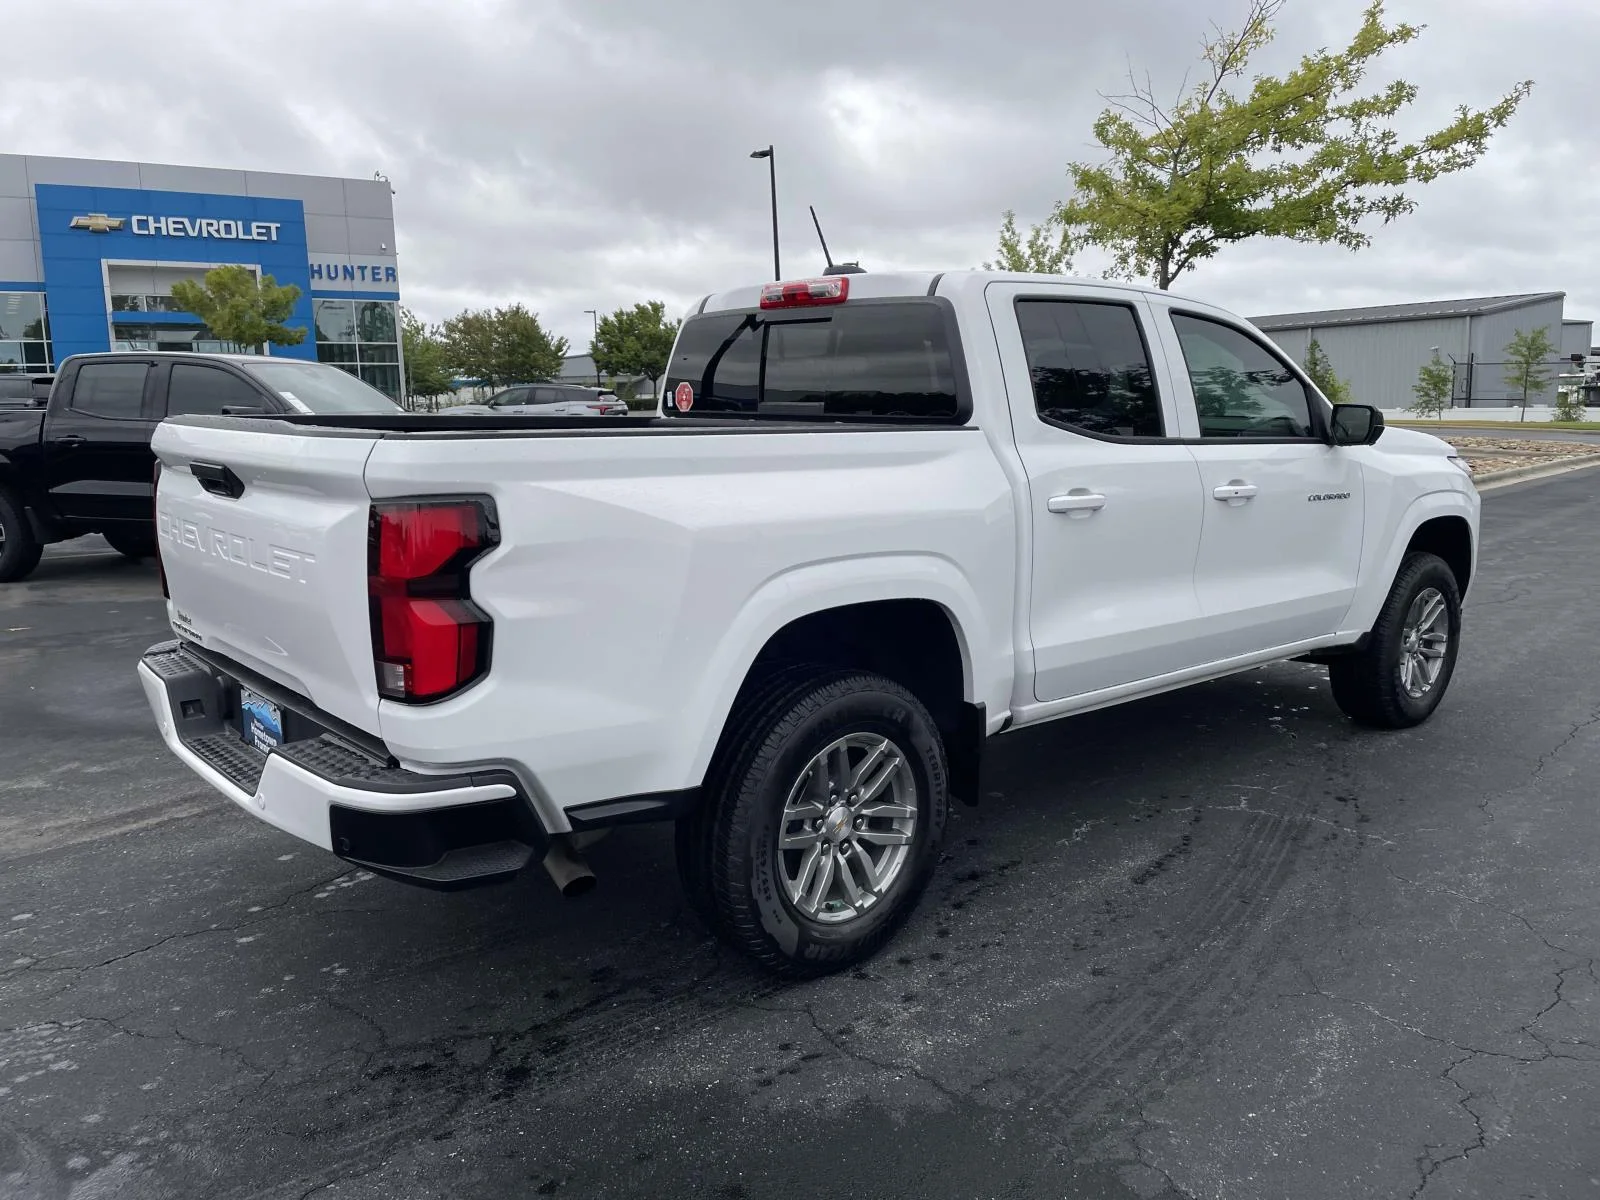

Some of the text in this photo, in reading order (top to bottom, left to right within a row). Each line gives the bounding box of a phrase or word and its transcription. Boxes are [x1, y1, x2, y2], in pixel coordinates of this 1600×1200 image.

[131, 215, 281, 242] CHEVROLET
[310, 263, 397, 283] HUNTER
[1307, 492, 1351, 502] COLORADO
[159, 511, 316, 584] CHEVROLET
